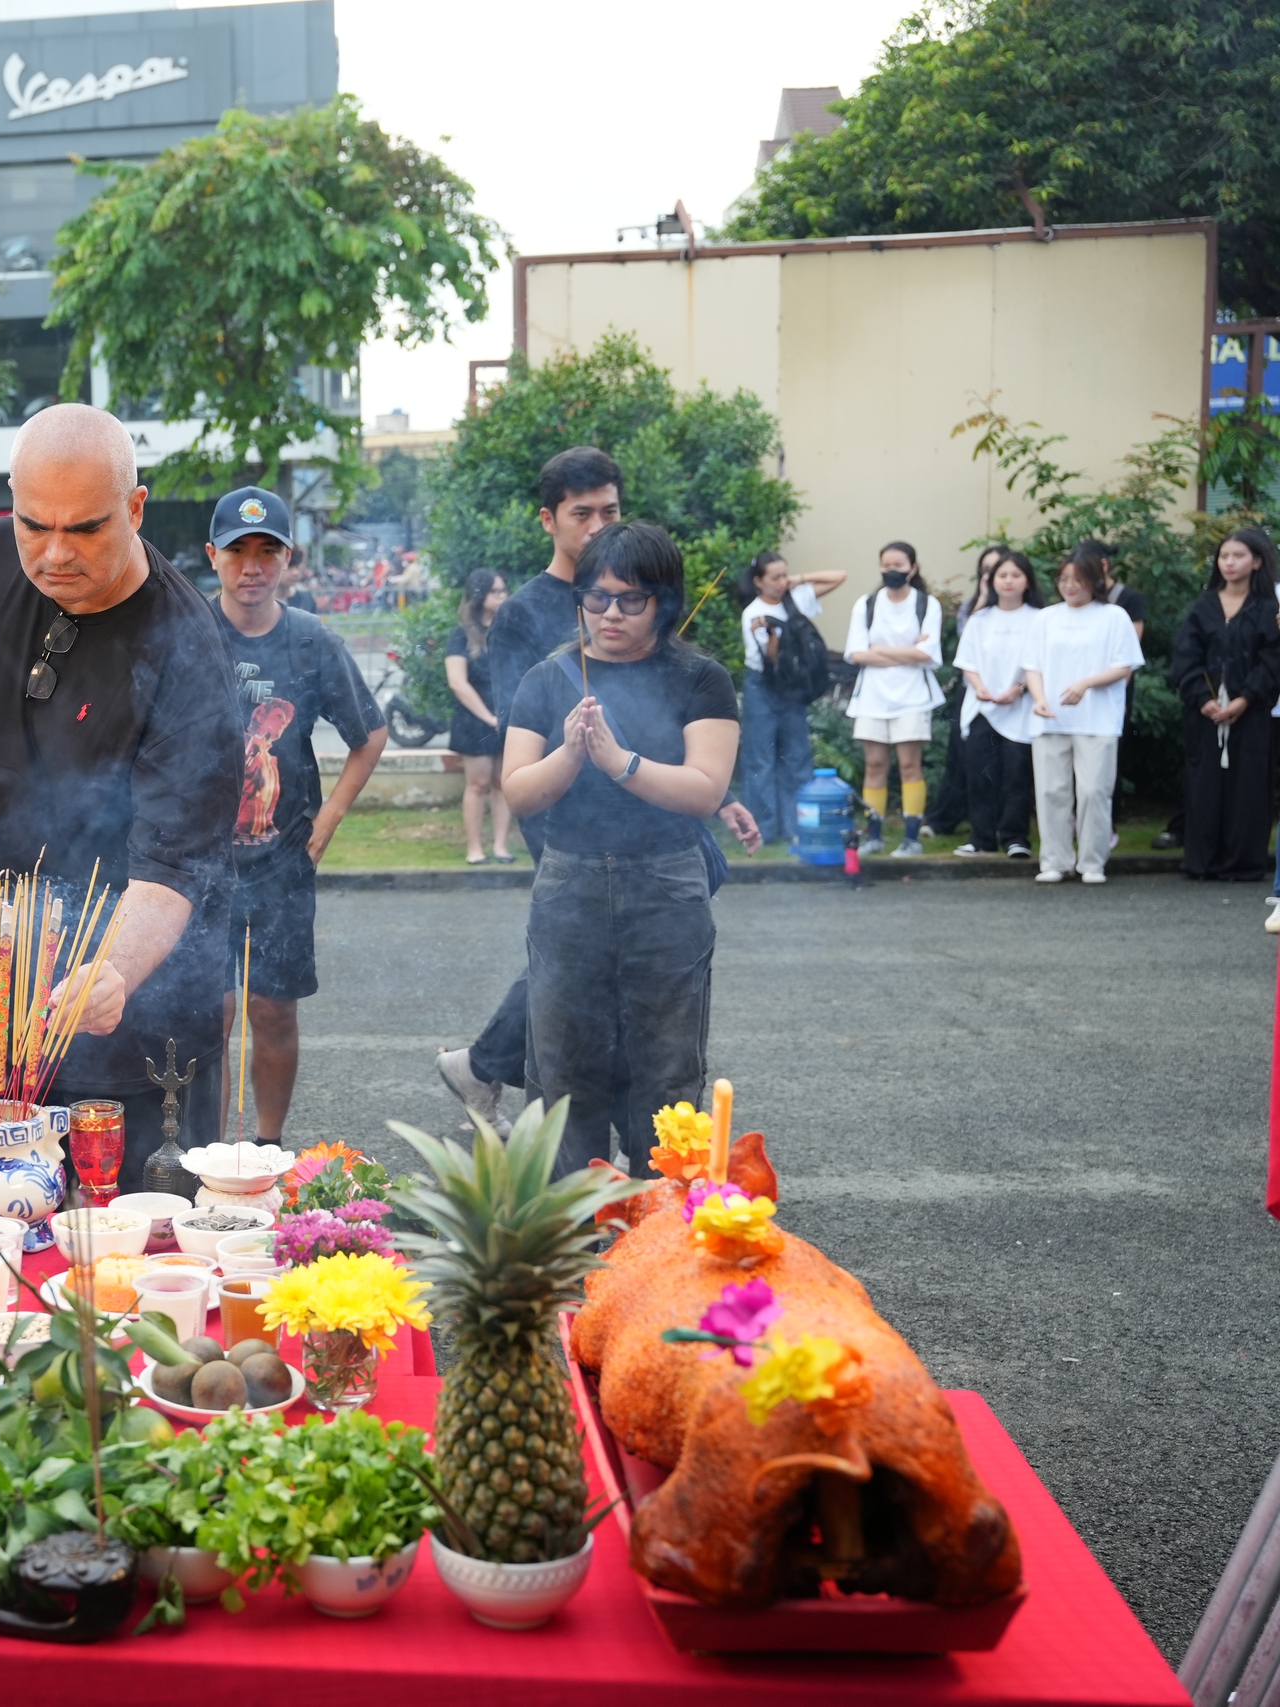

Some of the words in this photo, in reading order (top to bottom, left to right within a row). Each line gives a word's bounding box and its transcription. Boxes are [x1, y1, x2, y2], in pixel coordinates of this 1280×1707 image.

[2, 52, 189, 121] Vespa
[235, 661, 260, 679] VID
[236, 680, 275, 703] WIE
